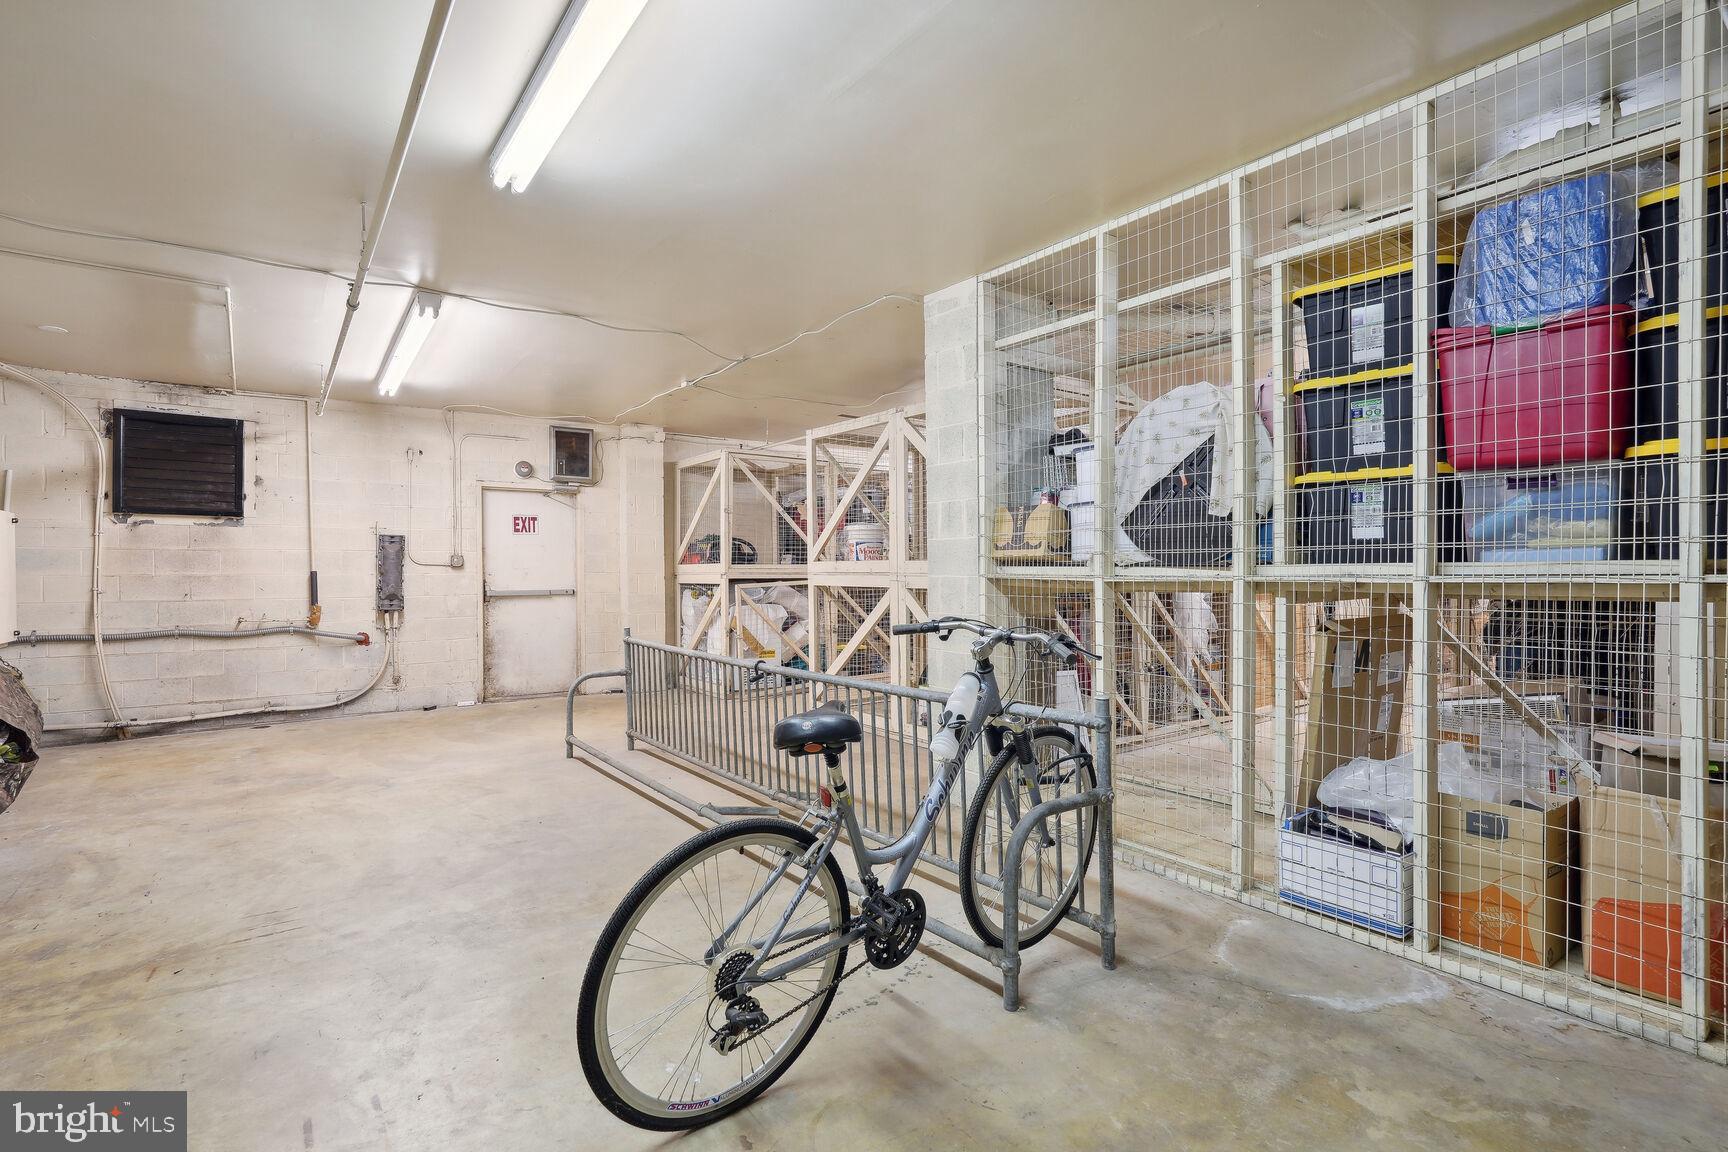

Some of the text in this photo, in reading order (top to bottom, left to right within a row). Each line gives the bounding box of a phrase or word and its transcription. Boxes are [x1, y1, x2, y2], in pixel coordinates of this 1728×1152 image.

[513, 516, 538, 533] EXIT
[667, 1099, 711, 1111] SCHWINN
[745, 1073, 760, 1087] ALLOY
